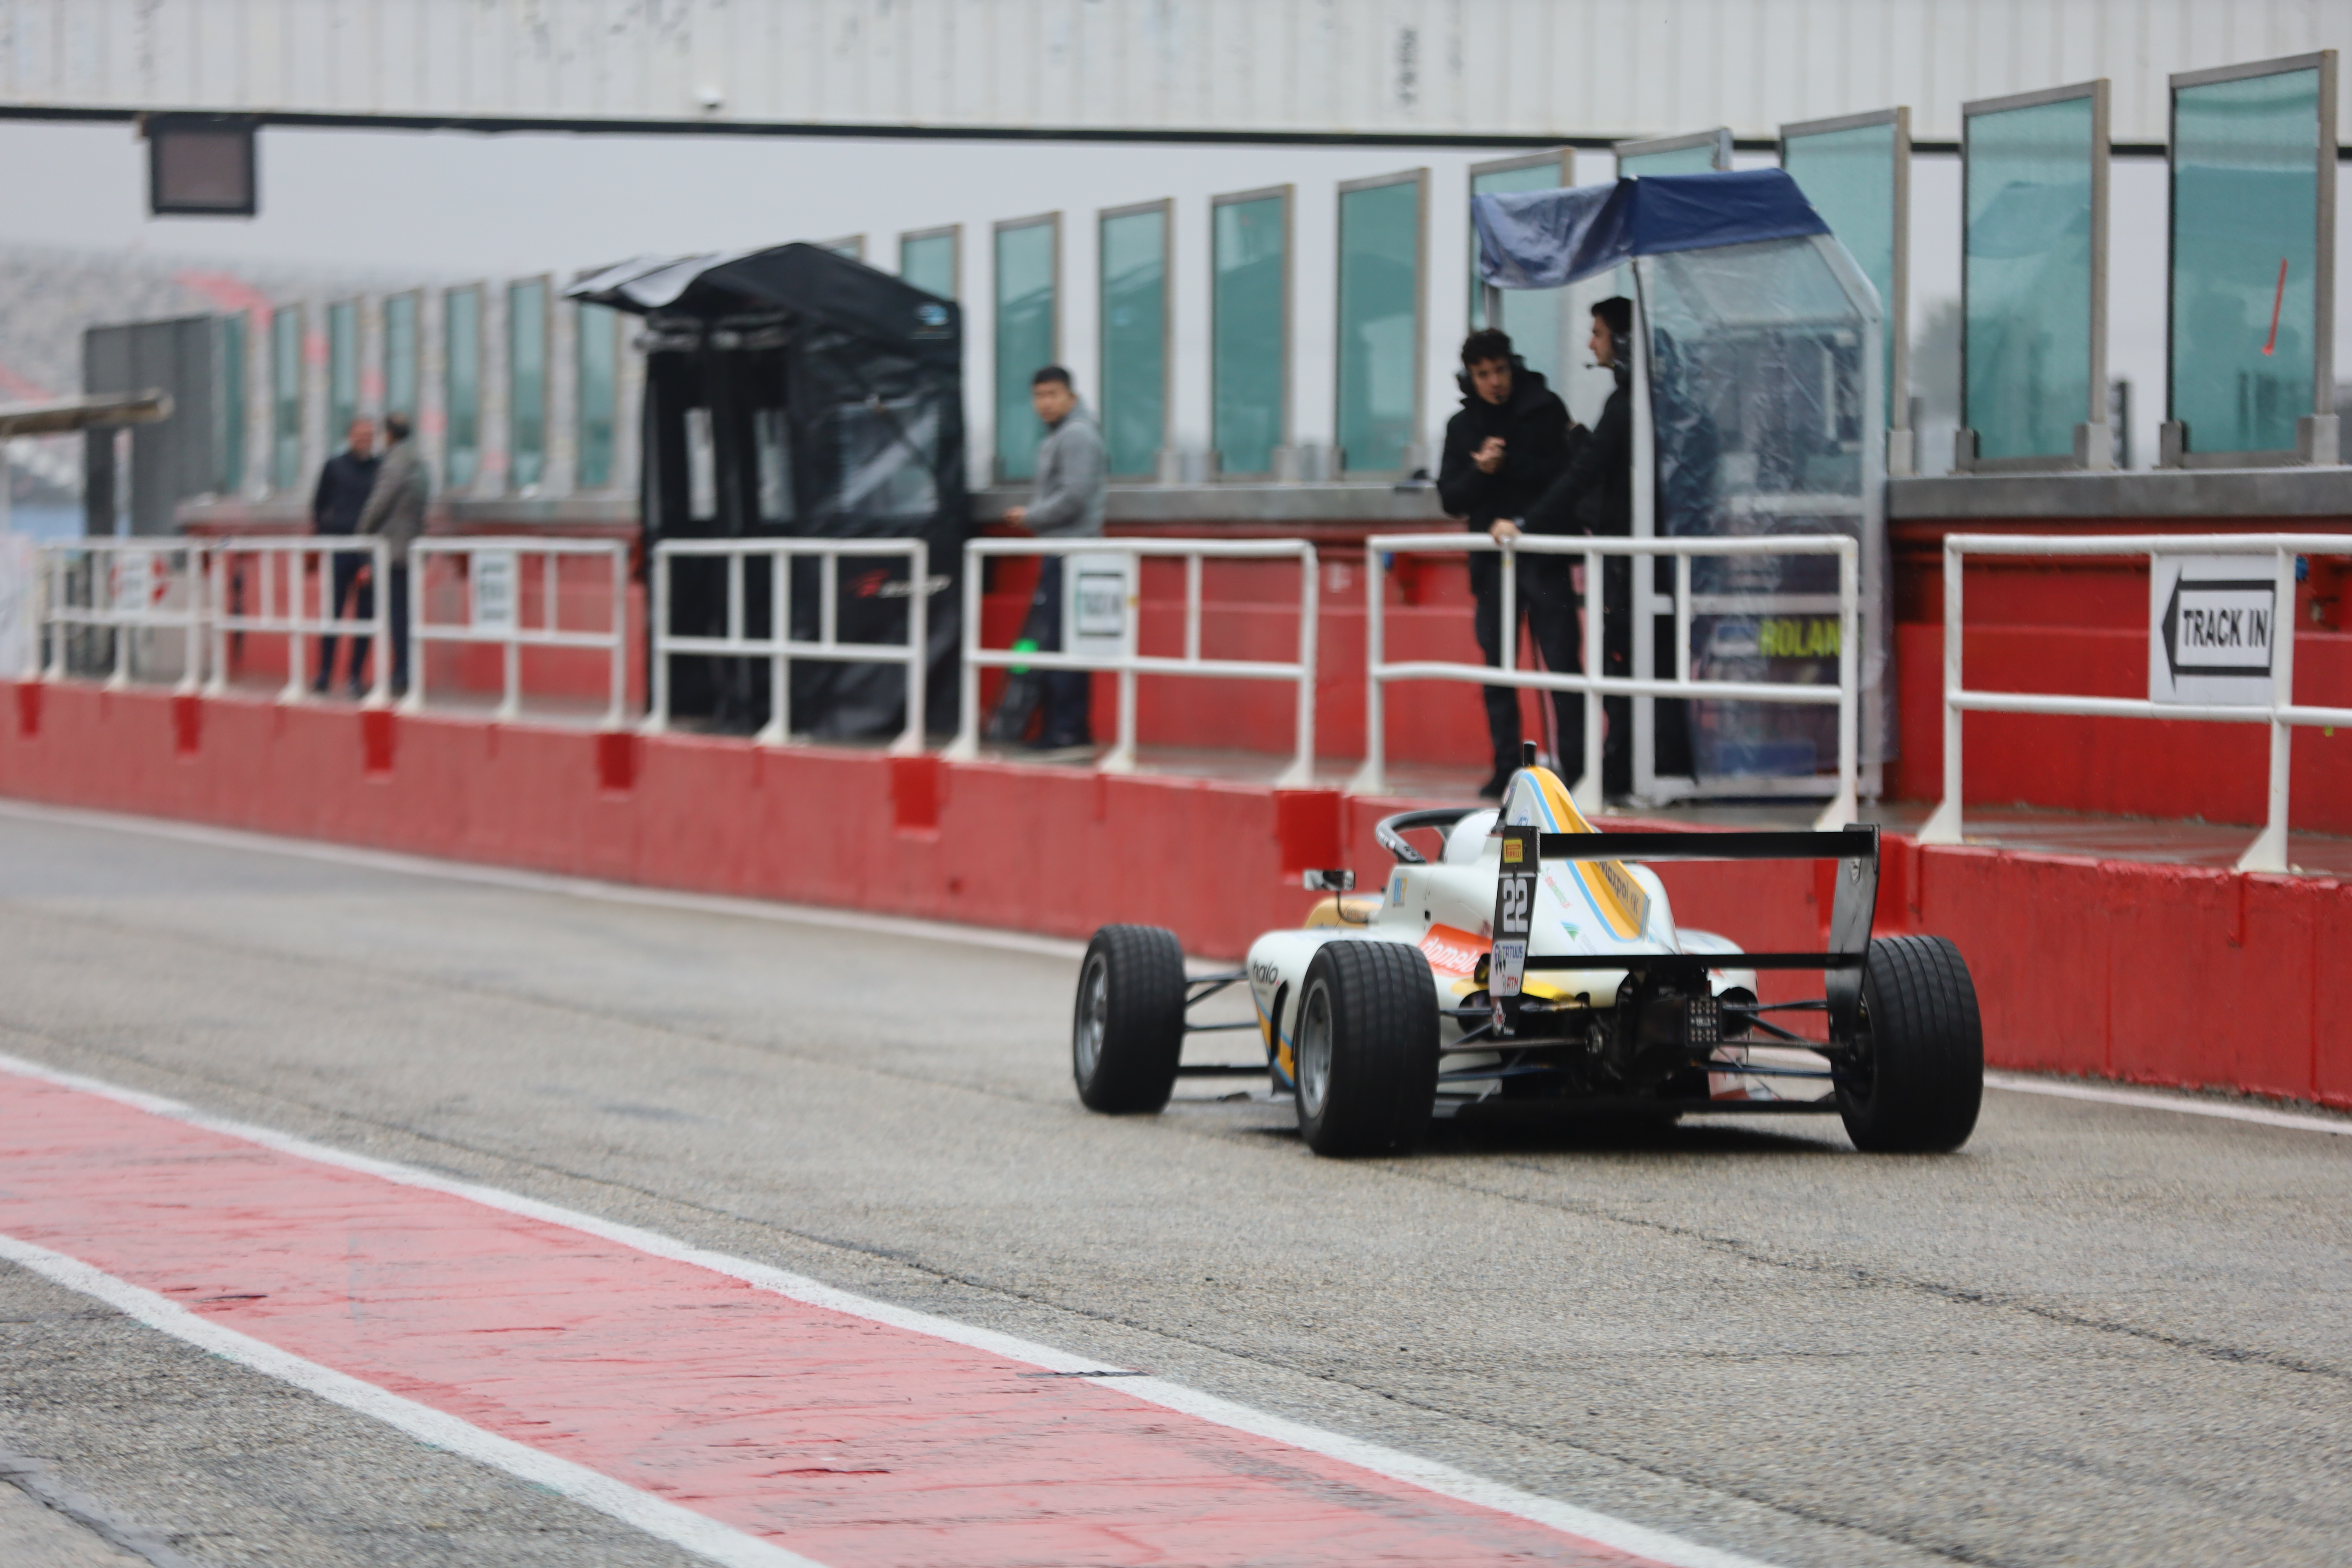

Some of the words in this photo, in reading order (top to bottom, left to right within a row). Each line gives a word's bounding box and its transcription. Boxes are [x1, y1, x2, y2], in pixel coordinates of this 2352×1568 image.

[2183, 609, 2243, 648] TRACK
[2248, 609, 2268, 648] IN
[1505, 844, 1521, 858] PIRELLI
[1504, 878, 1528, 933] 22
[1502, 945, 1523, 959] TATUUS
[1507, 977, 1518, 990] ATM
